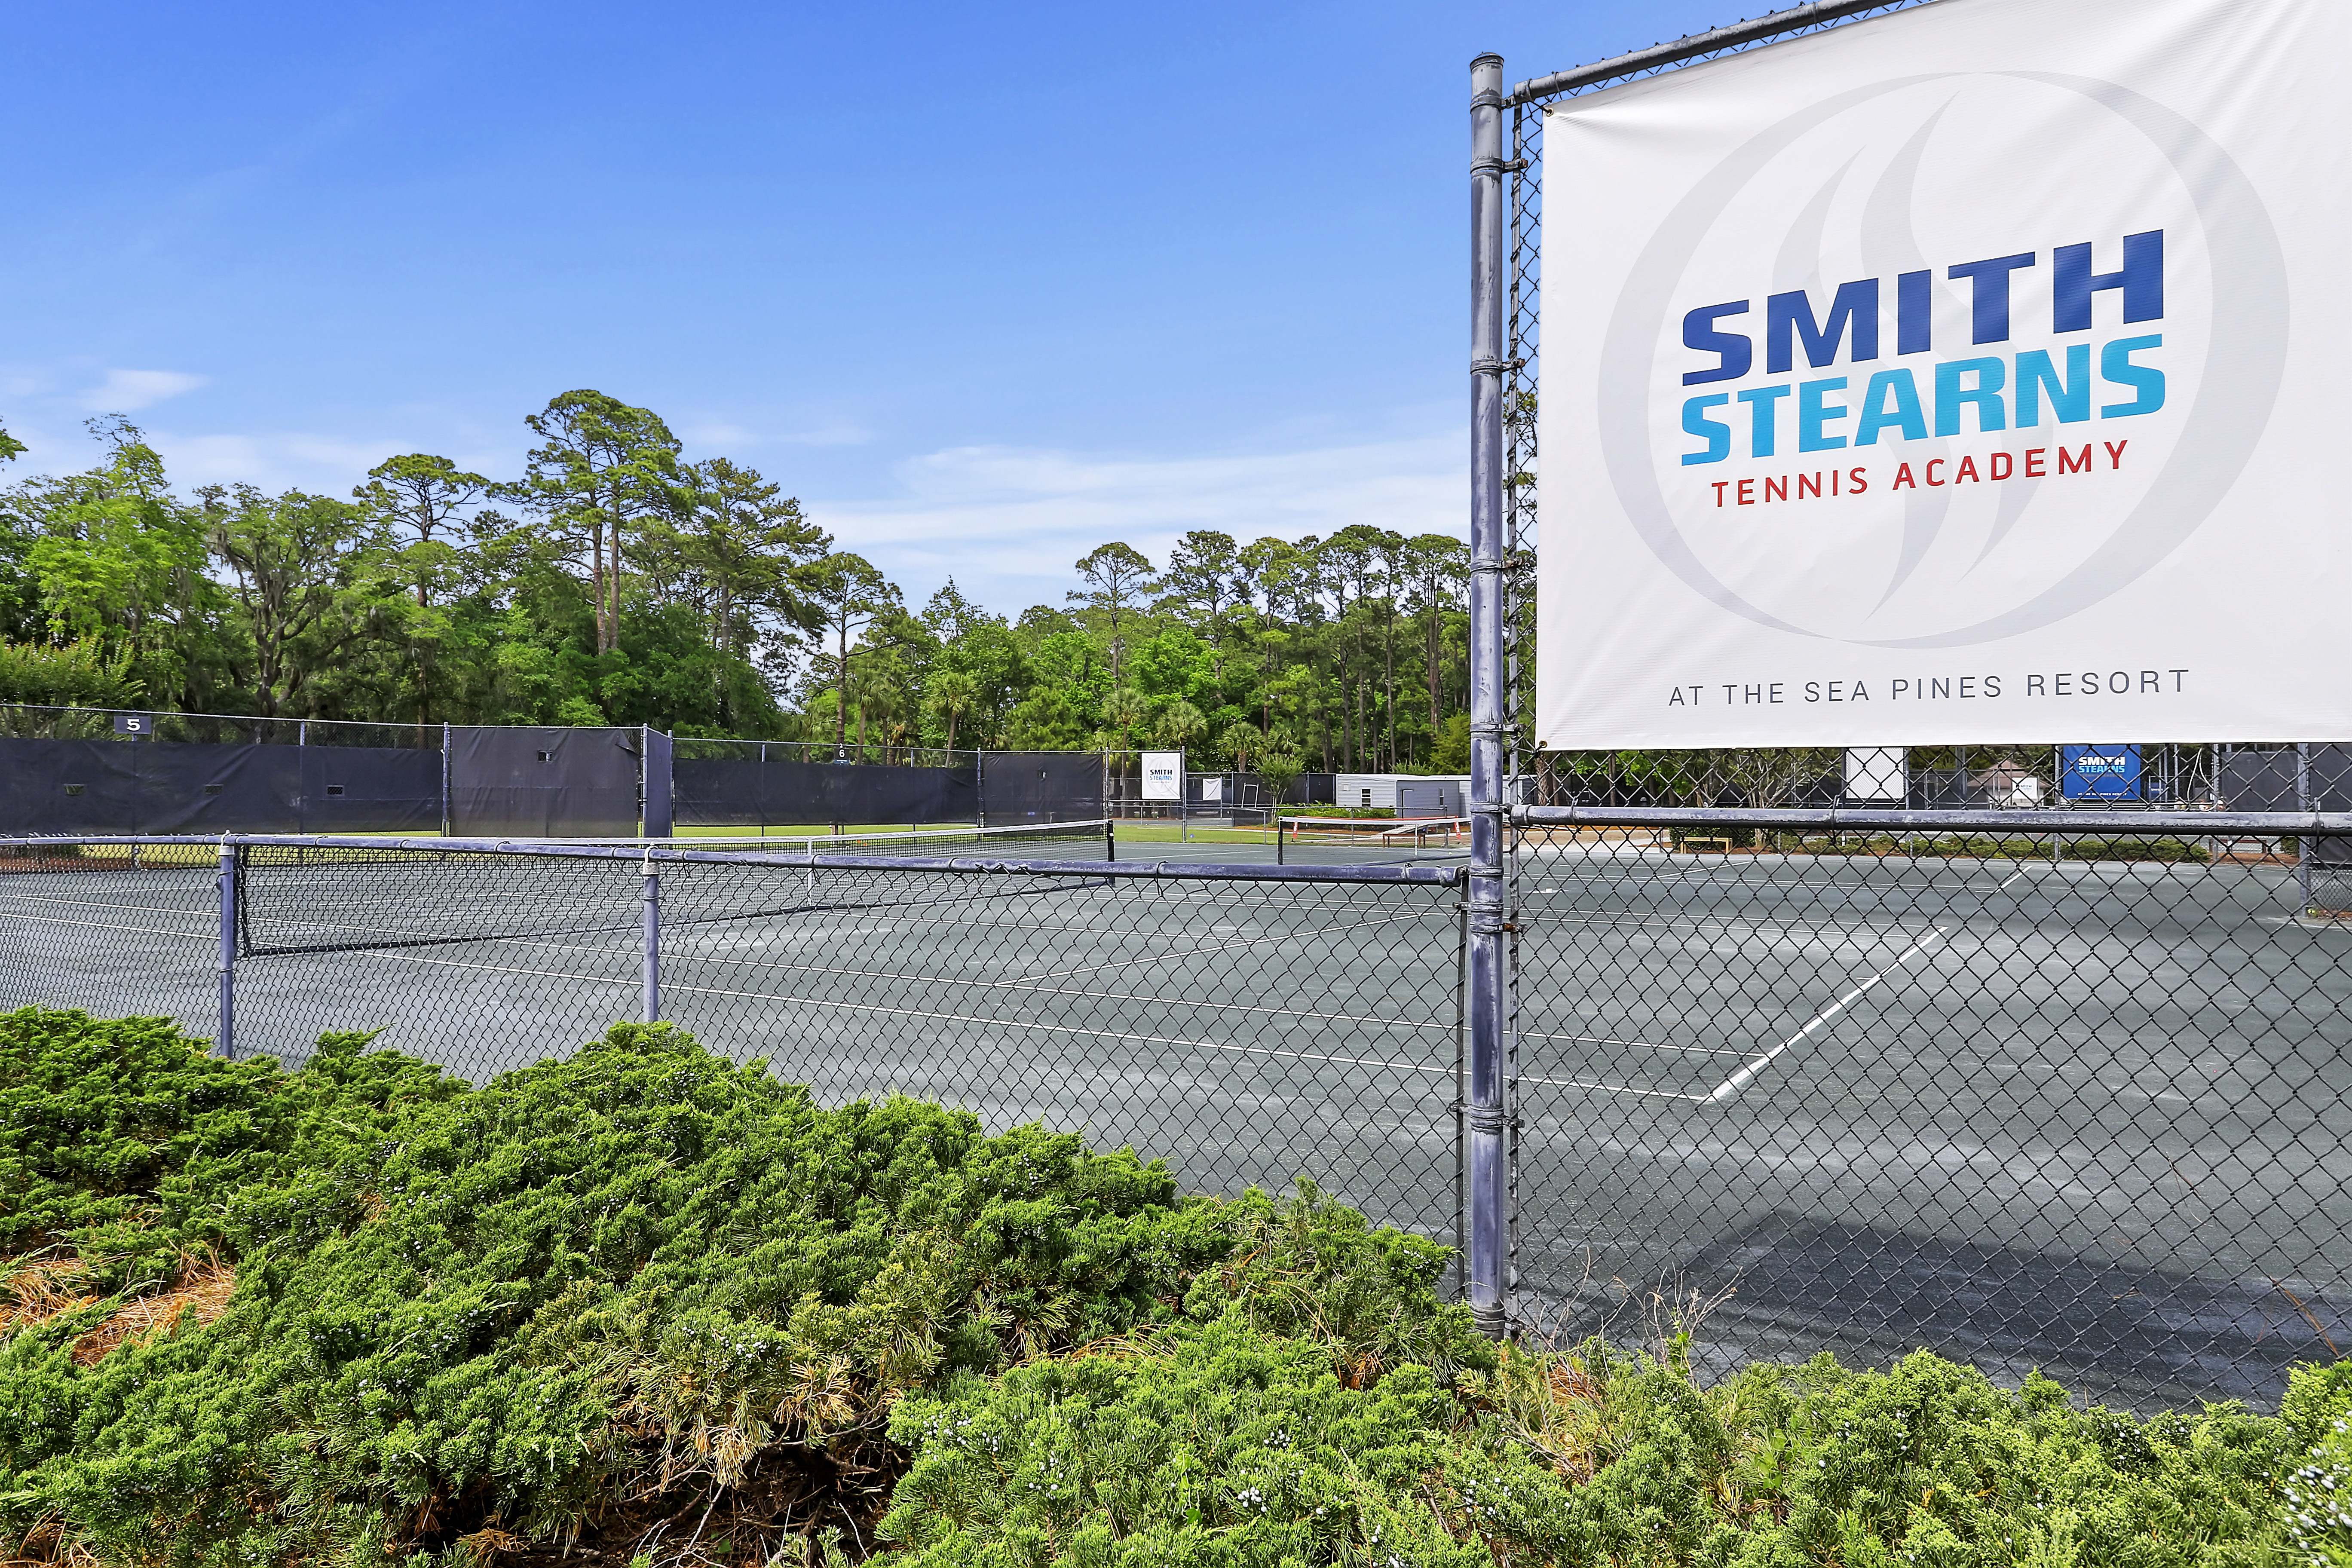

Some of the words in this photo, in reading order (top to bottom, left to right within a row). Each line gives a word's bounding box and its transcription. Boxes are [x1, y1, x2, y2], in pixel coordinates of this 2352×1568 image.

[1683, 230, 2164, 386] SMITH
[1681, 334, 2166, 466] STEARNS
[1712, 467, 1868, 507] TENNIS
[1893, 440, 2128, 490] ACADEMY
[1669, 686, 1703, 706] AT
[1722, 683, 1783, 704] THE
[1804, 680, 1869, 702] SEA
[1893, 676, 2001, 700] PINES
[2027, 669, 2189, 696] RESORT
[127, 719, 141, 731] 5
[839, 749, 845, 757] 6
[2078, 756, 2125, 766] SMITH
